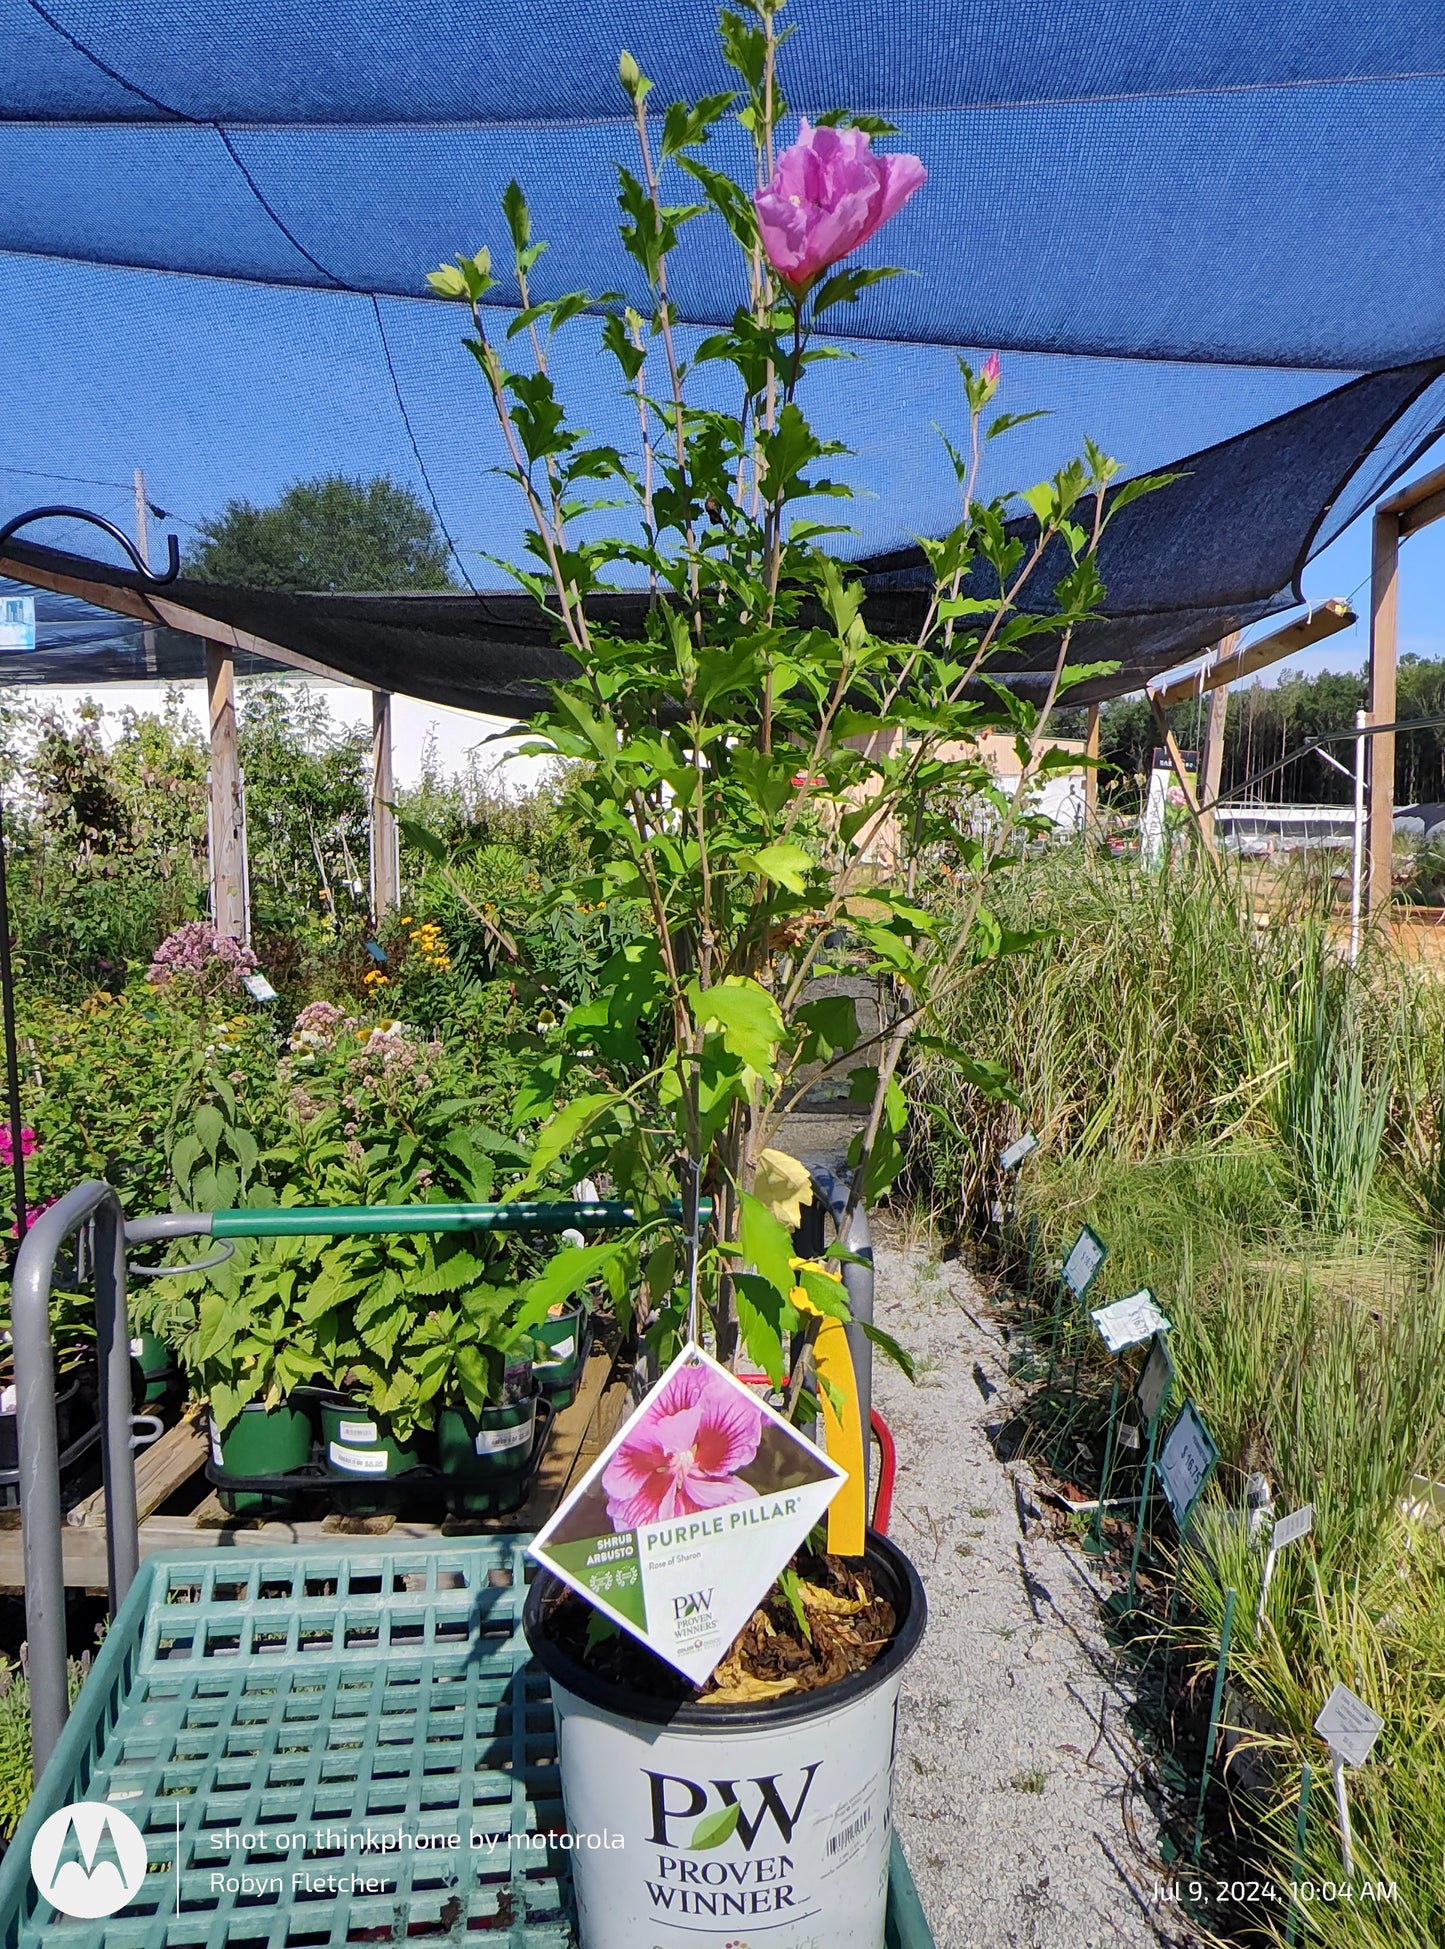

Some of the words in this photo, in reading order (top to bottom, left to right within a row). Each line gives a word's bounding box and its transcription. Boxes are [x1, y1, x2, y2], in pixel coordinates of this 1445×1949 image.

[597, 1534, 633, 1550] SHRUB
[647, 1517, 723, 1551] PURPLE
[587, 1547, 634, 1566] ARBUSTO
[648, 1560, 666, 1571] Rose
[667, 1556, 676, 1566] of
[677, 1551, 701, 1563] Sharon
[672, 1587, 715, 1620] PW
[677, 1612, 713, 1630] PROVEN
[640, 1760, 824, 1852] PW
[656, 1854, 794, 1886] PROVEN
